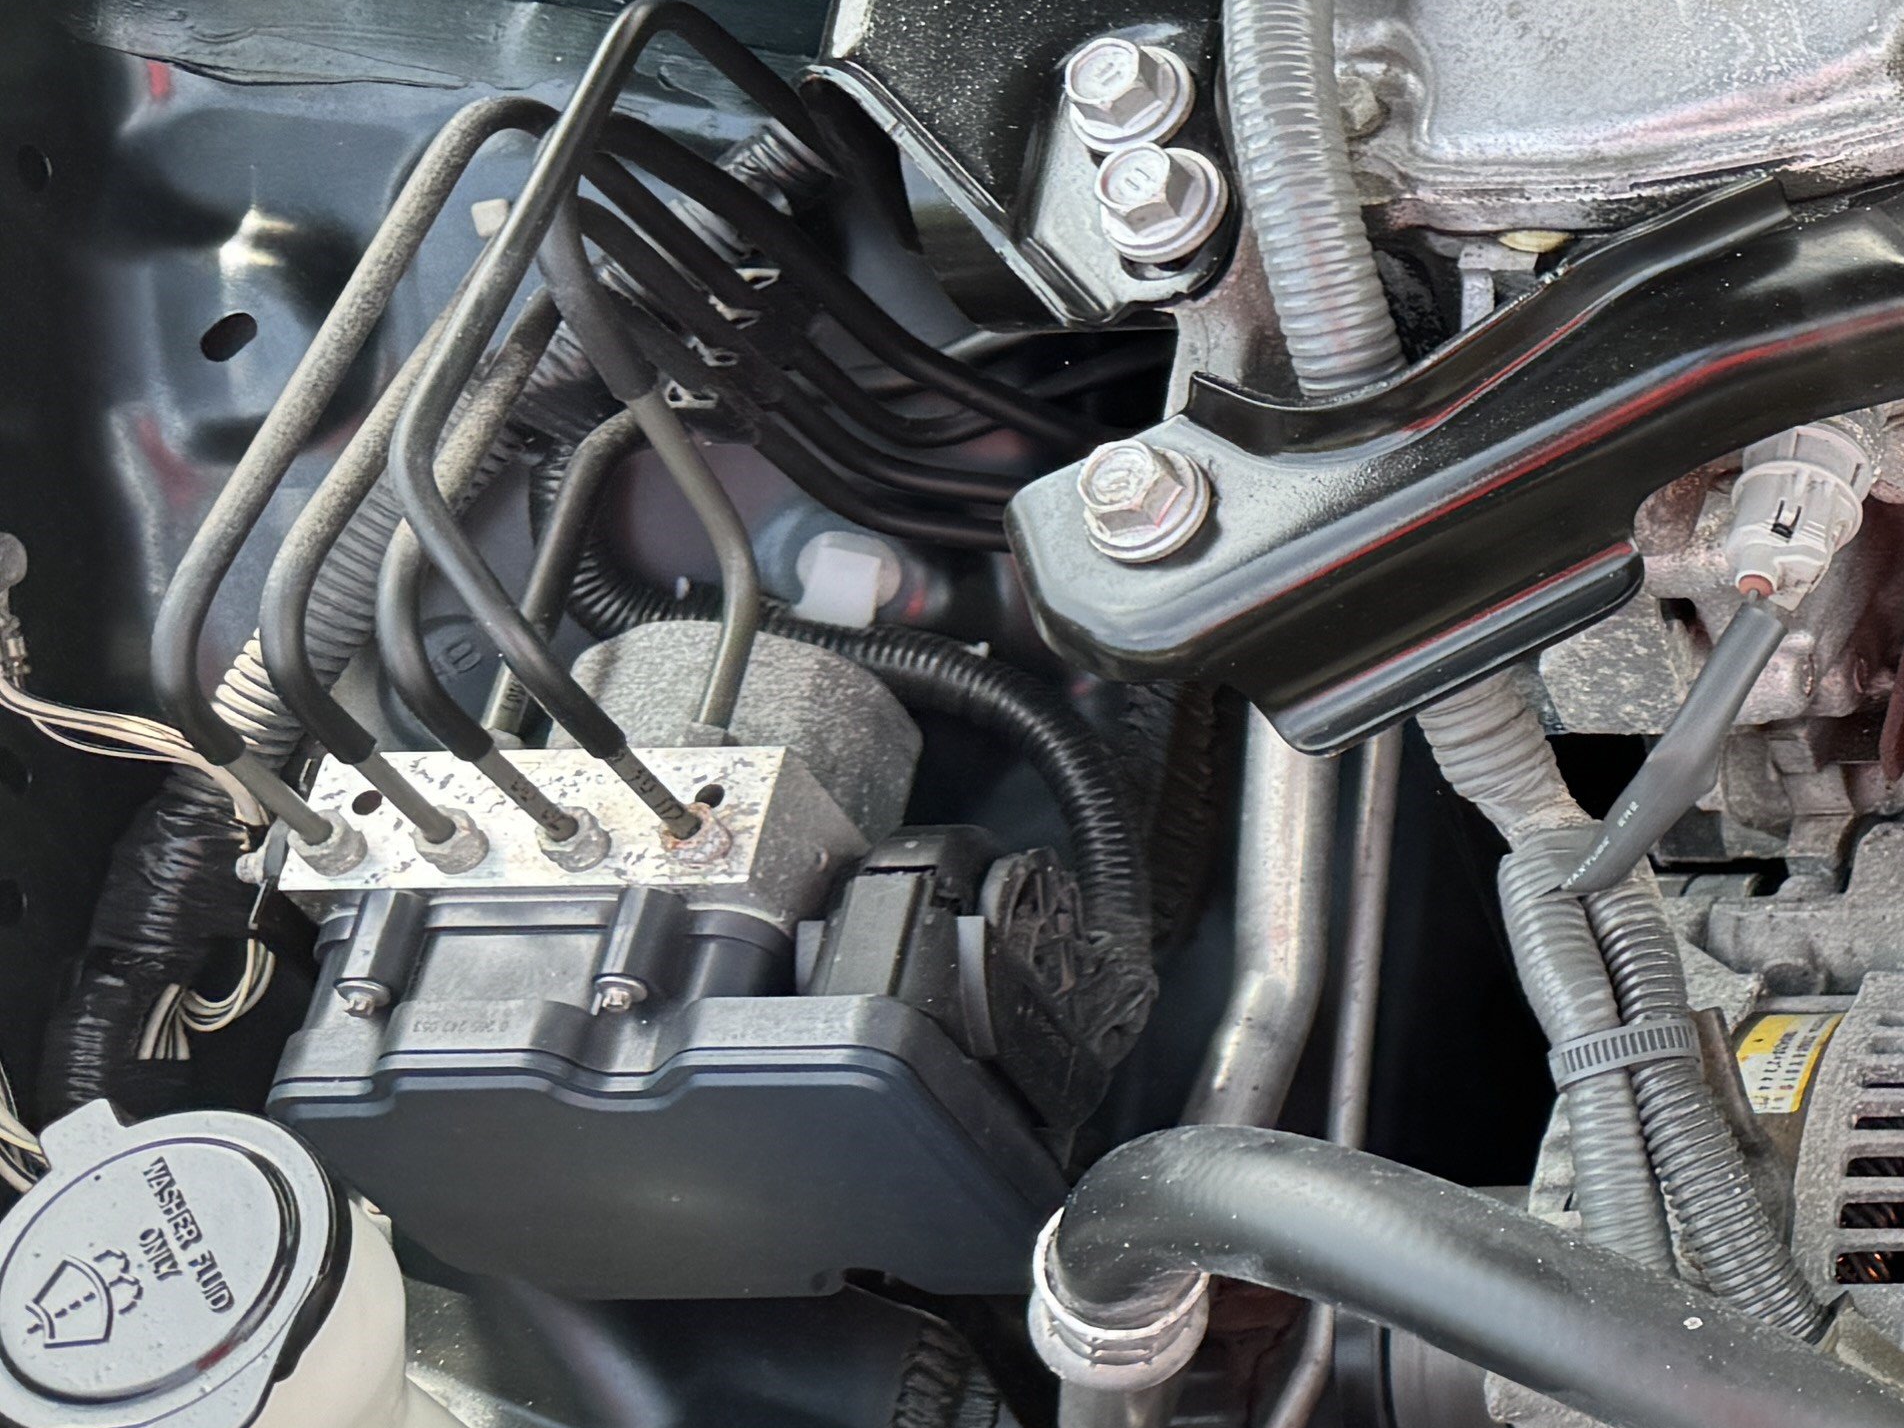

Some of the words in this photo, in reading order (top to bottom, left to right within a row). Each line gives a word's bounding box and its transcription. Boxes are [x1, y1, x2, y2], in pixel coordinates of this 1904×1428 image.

[139, 1227, 183, 1281] ONLY
[143, 1156, 203, 1252] WASHER
[188, 1249, 235, 1314] FLUID
